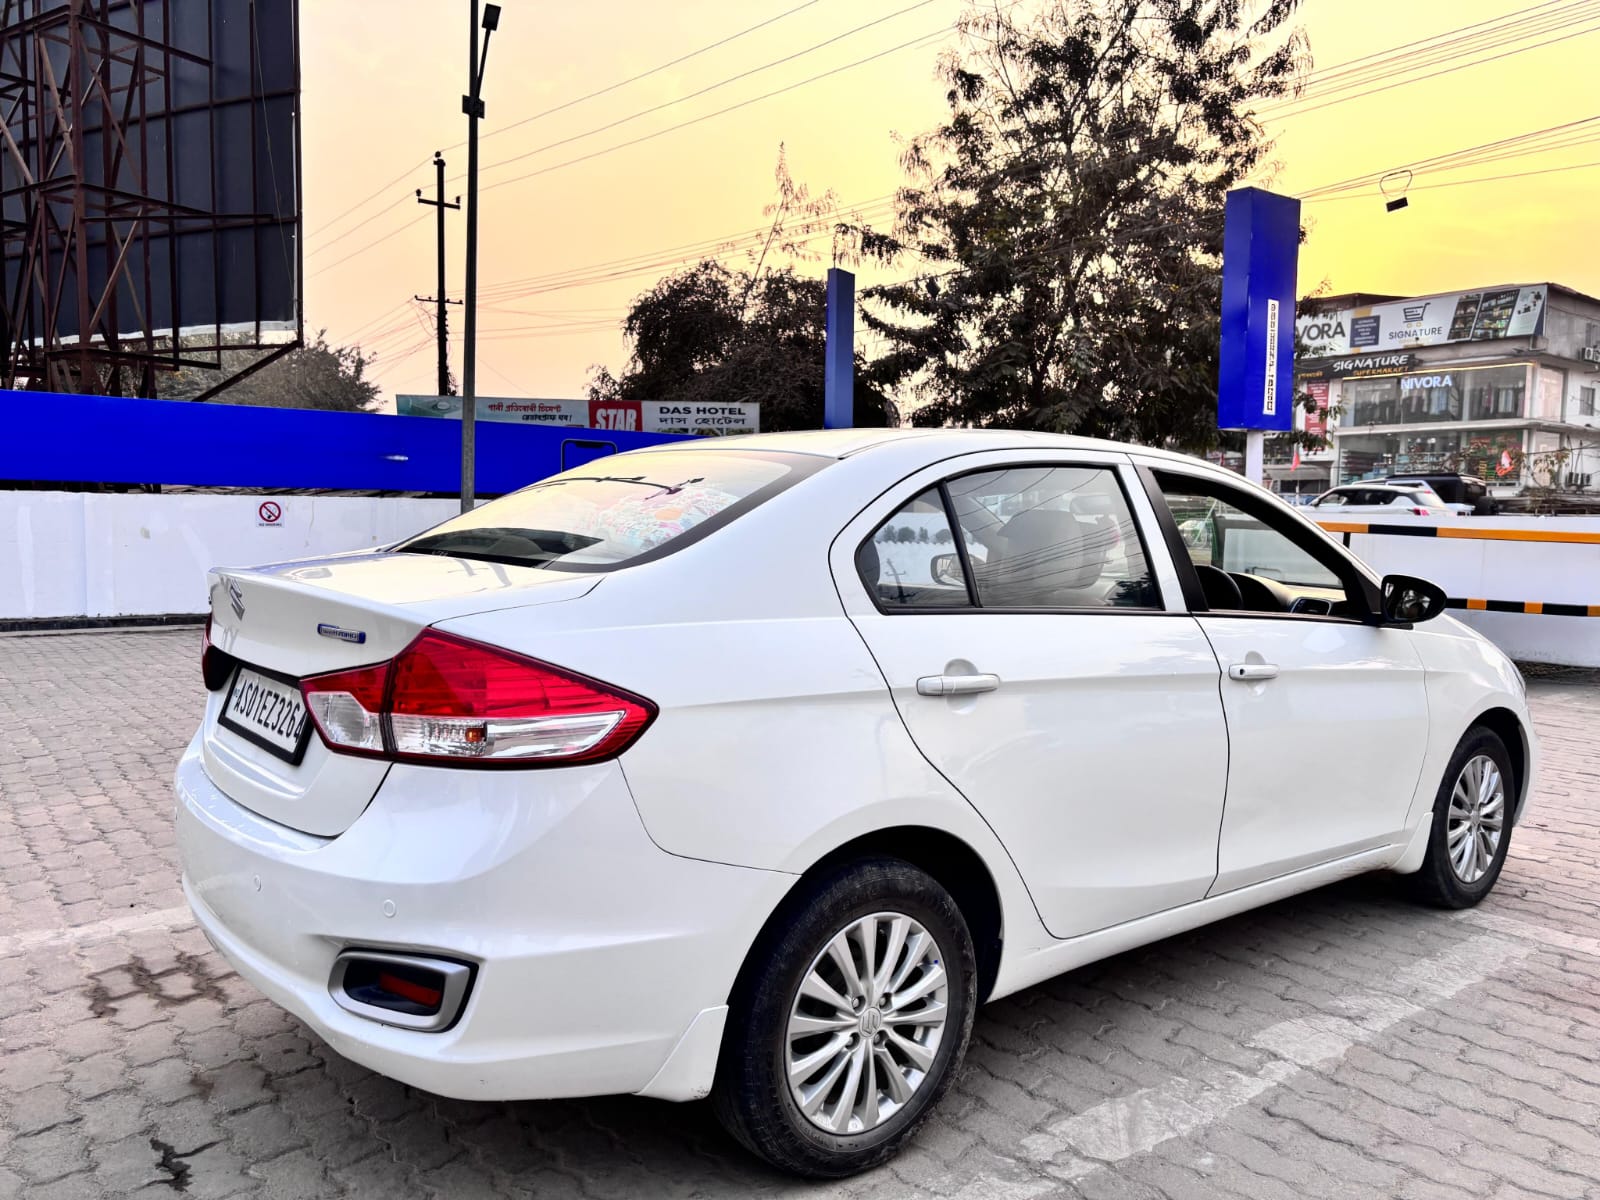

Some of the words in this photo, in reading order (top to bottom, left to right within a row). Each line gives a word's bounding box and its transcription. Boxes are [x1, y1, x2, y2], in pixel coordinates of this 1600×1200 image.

[1388, 327, 1443, 340] SIGNATURE
[1332, 354, 1409, 372] SIGNATURE
[1401, 375, 1453, 390] NIVORA
[659, 406, 692, 415] DAS
[696, 406, 746, 416] HOTEL
[595, 408, 638, 431] STAR
[233, 680, 307, 743] AS01EZ3264
